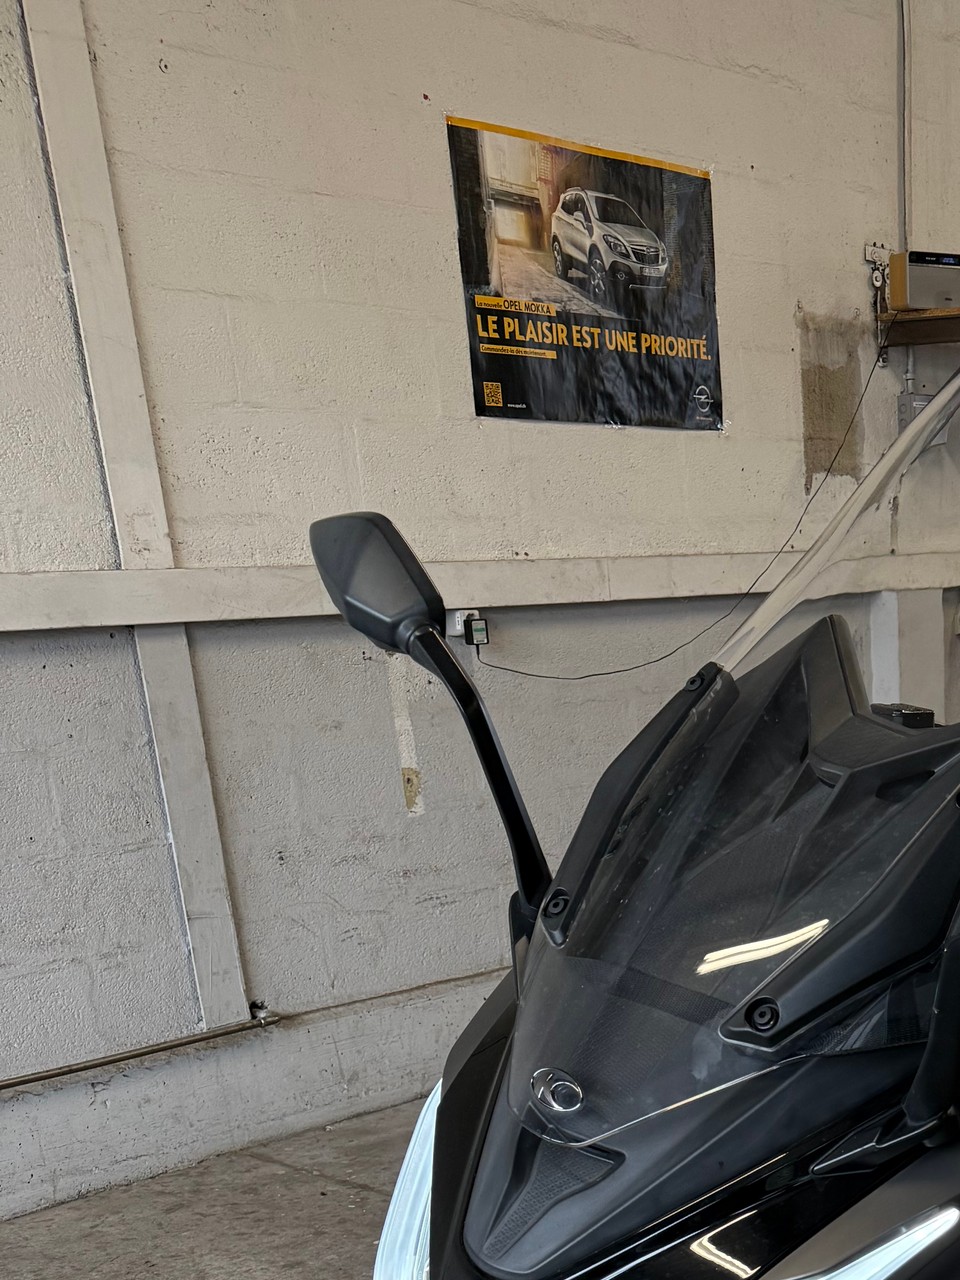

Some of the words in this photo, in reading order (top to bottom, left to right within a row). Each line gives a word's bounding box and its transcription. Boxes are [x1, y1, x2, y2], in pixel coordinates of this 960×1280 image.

[503, 299, 523, 311] OPEL
[524, 302, 552, 315] MOKKA
[476, 314, 500, 339] LE
[503, 317, 569, 346] PLAISIR
[572, 325, 601, 349] EST
[604, 329, 638, 354] UNE
[641, 333, 712, 361] PRIORITÉ.
